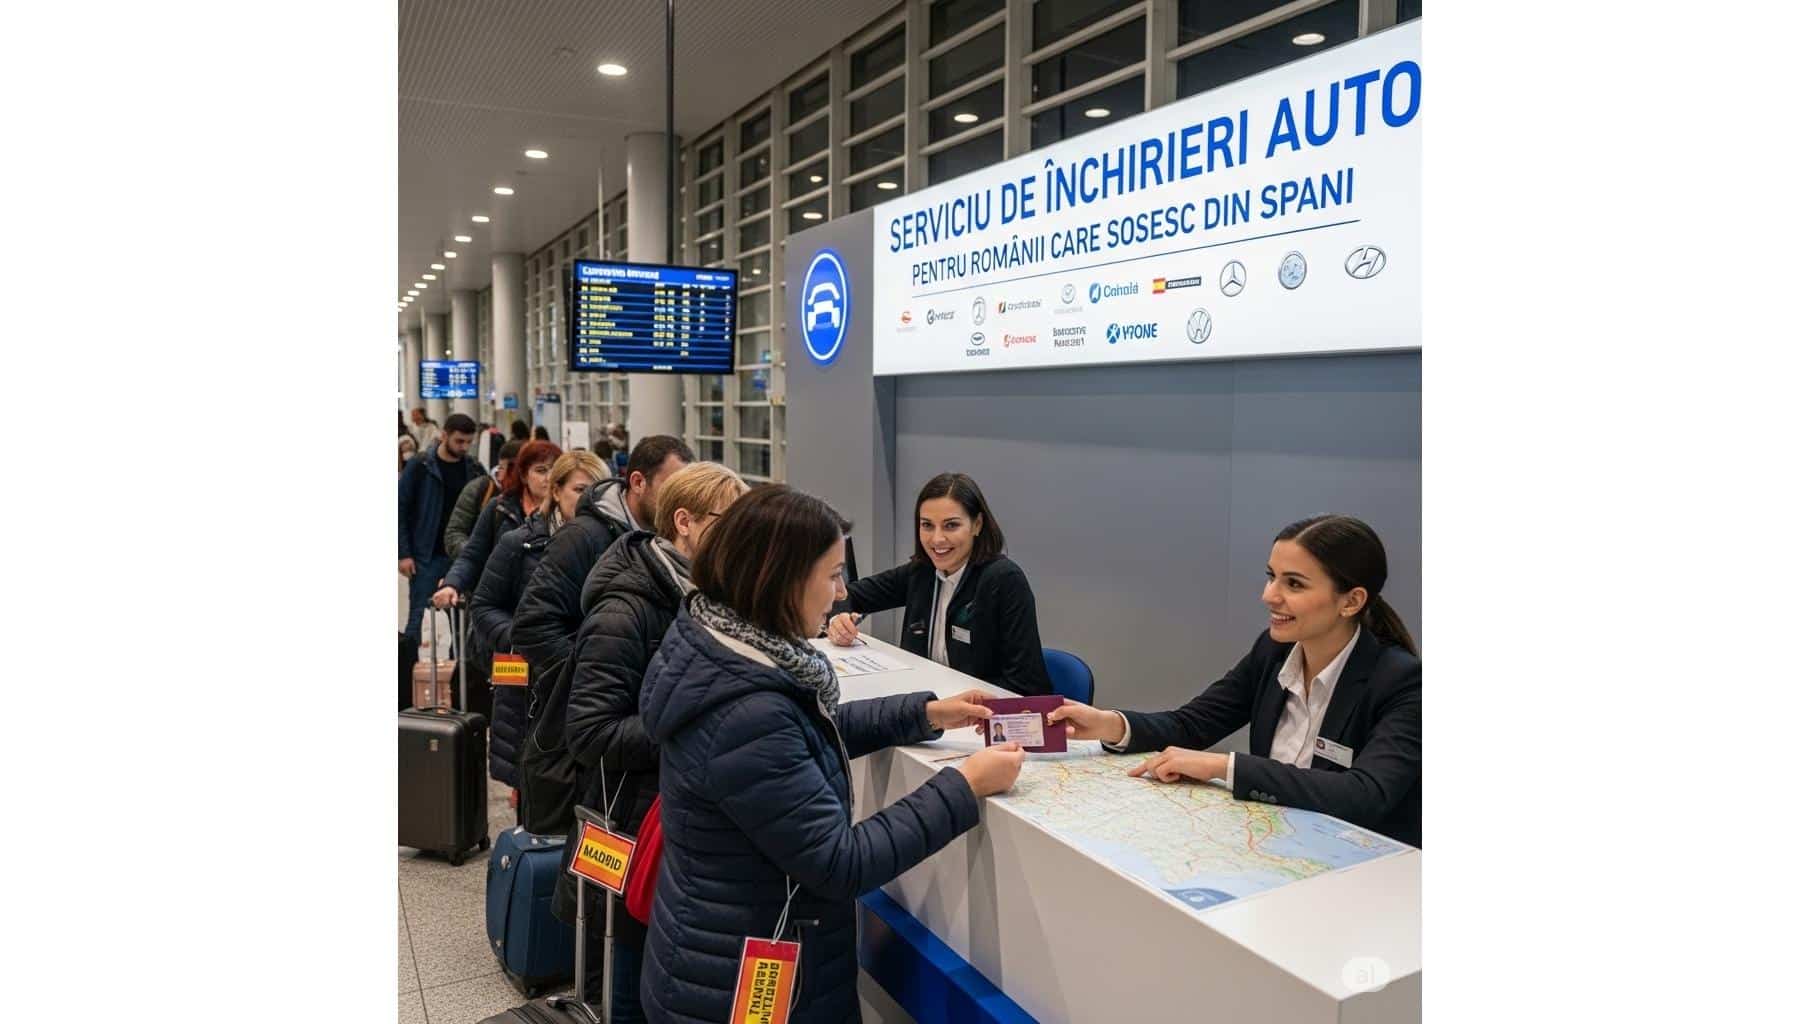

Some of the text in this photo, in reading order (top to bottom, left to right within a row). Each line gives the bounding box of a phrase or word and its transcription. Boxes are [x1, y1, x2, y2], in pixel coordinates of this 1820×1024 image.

[890, 60, 1422, 253] SERVICIU DE ÎNCHIRIERI AUTO
[912, 167, 1354, 286] PENTRU ROMÂNII CARE SOSESC DIN SPANI
